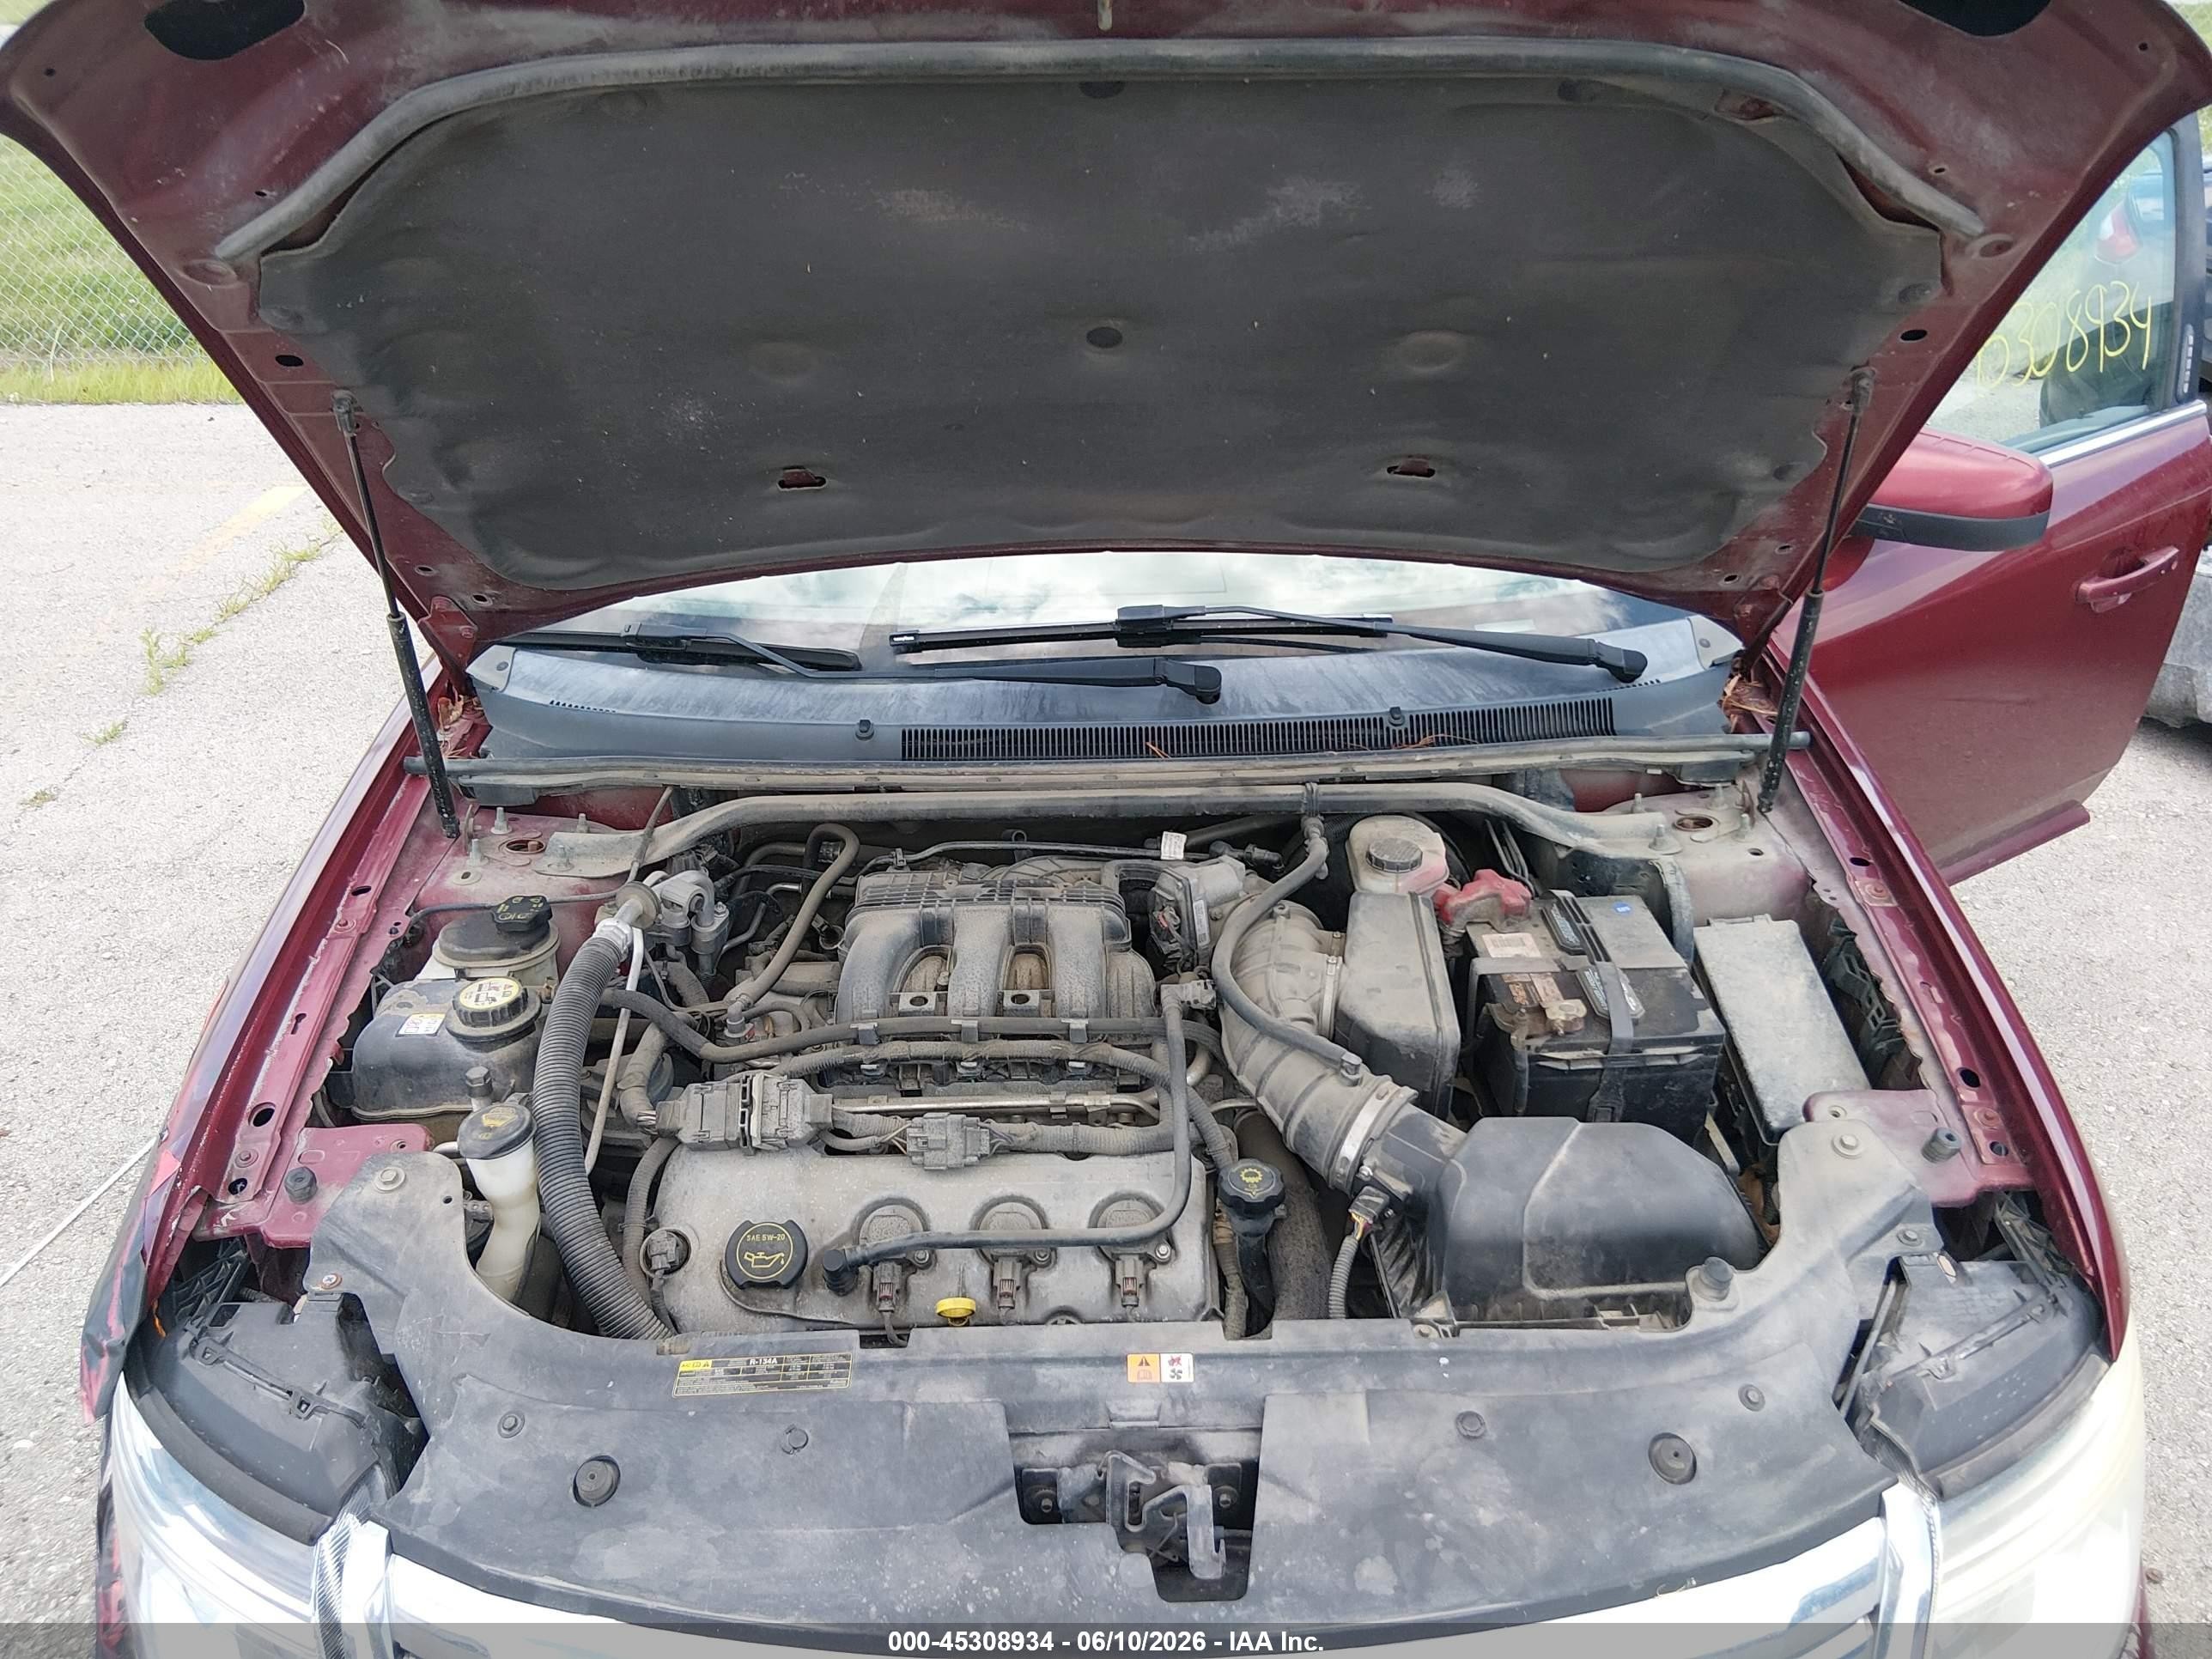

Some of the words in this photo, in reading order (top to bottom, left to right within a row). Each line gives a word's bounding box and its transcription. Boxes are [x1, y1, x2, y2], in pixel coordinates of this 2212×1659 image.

[746, 1234, 761, 1243] SAE
[762, 1233, 786, 1242] 5W-20
[749, 1357, 779, 1366] R-134A
